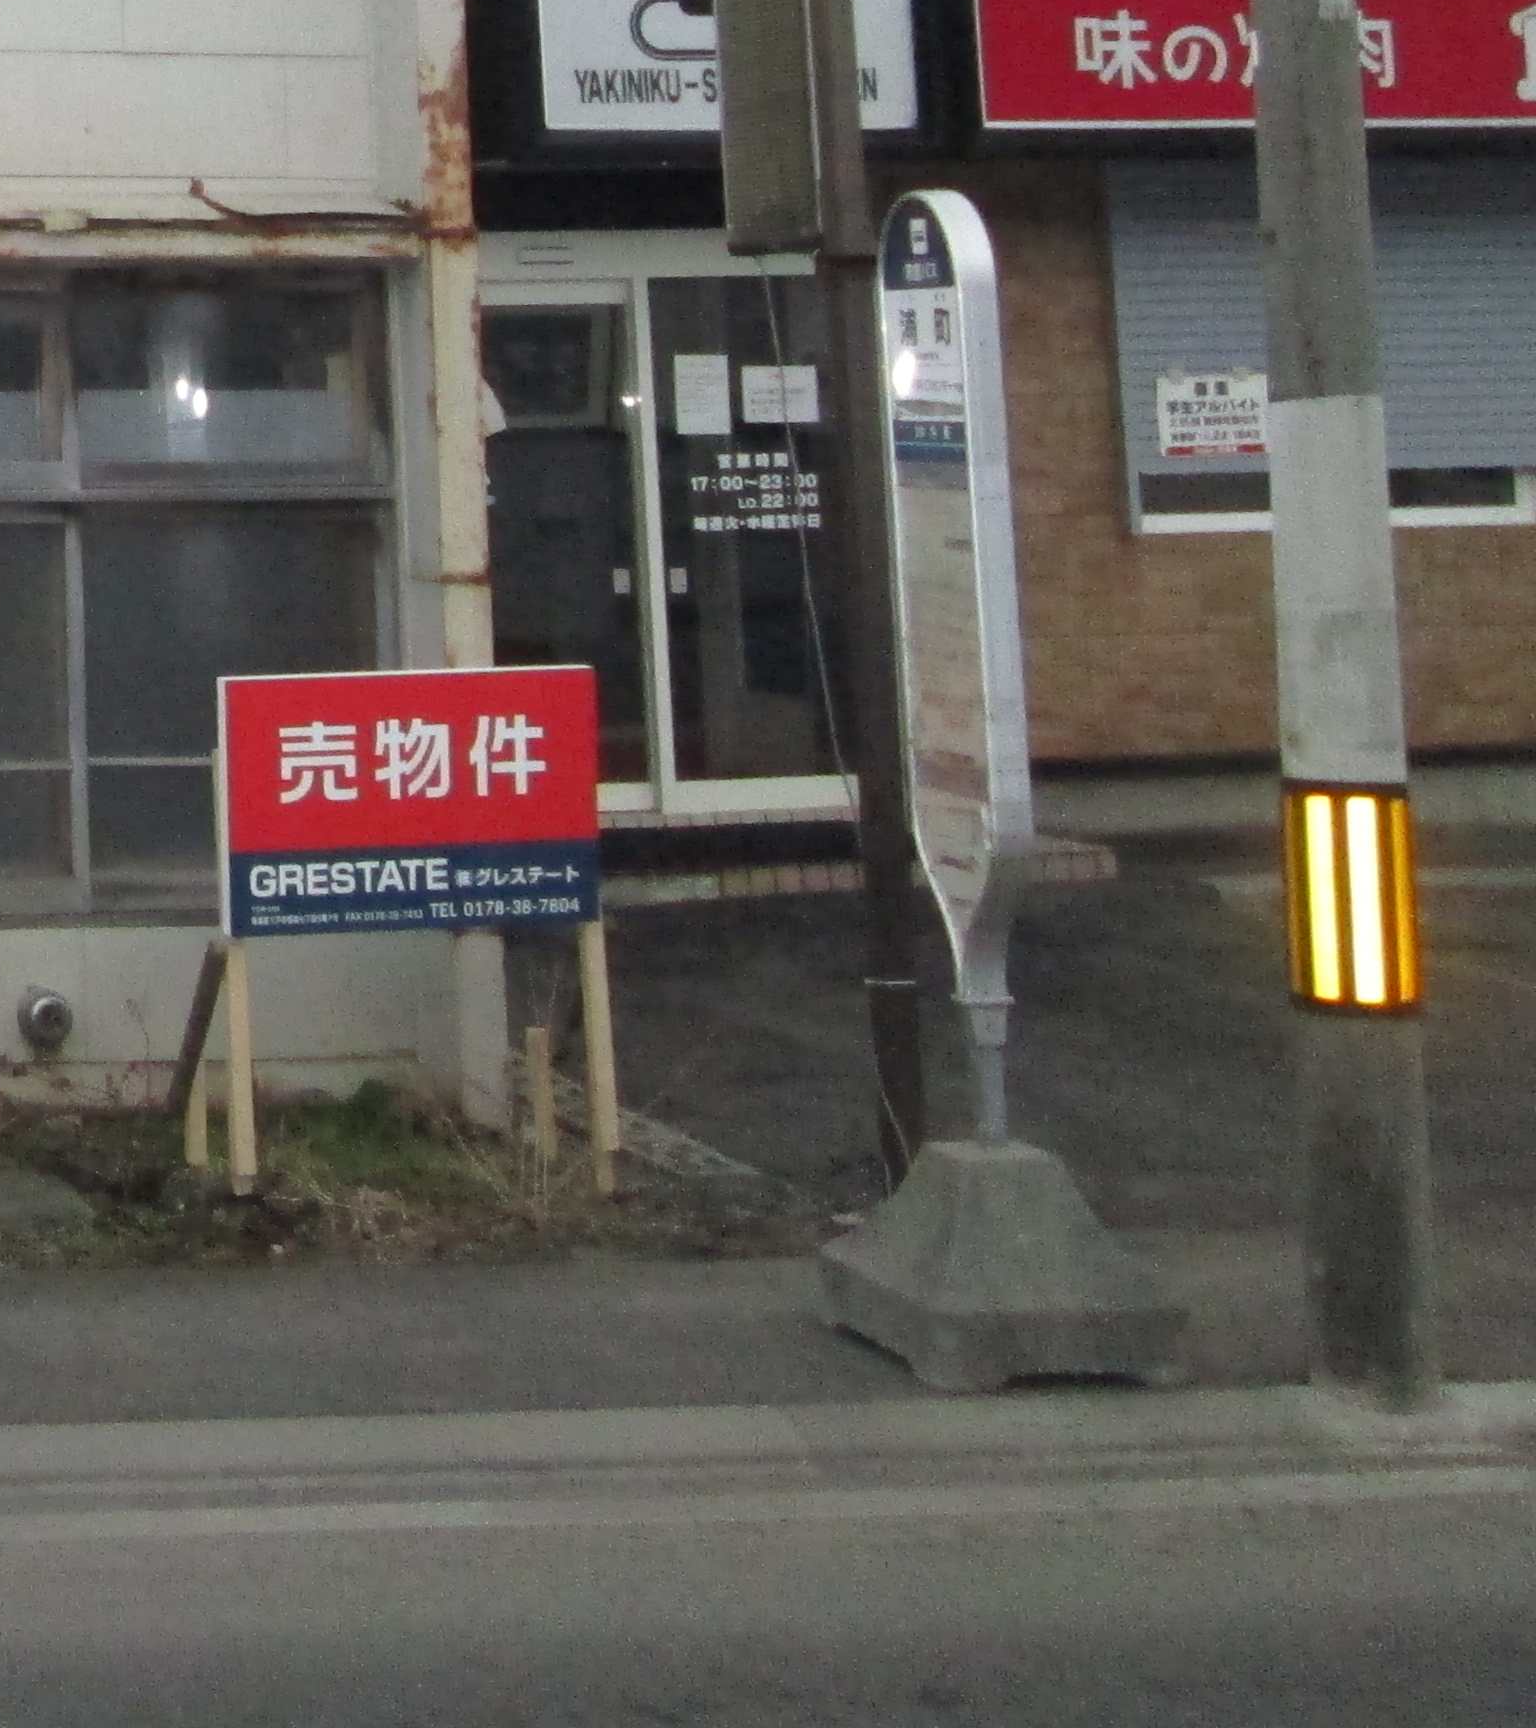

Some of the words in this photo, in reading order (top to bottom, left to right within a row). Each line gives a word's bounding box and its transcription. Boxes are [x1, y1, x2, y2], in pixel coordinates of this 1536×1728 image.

[1074, 9, 1398, 89] 味の肉
[279, 714, 547, 805] 売物件
[249, 857, 449, 898] GRESTATE
[430, 901, 458, 918] TEL
